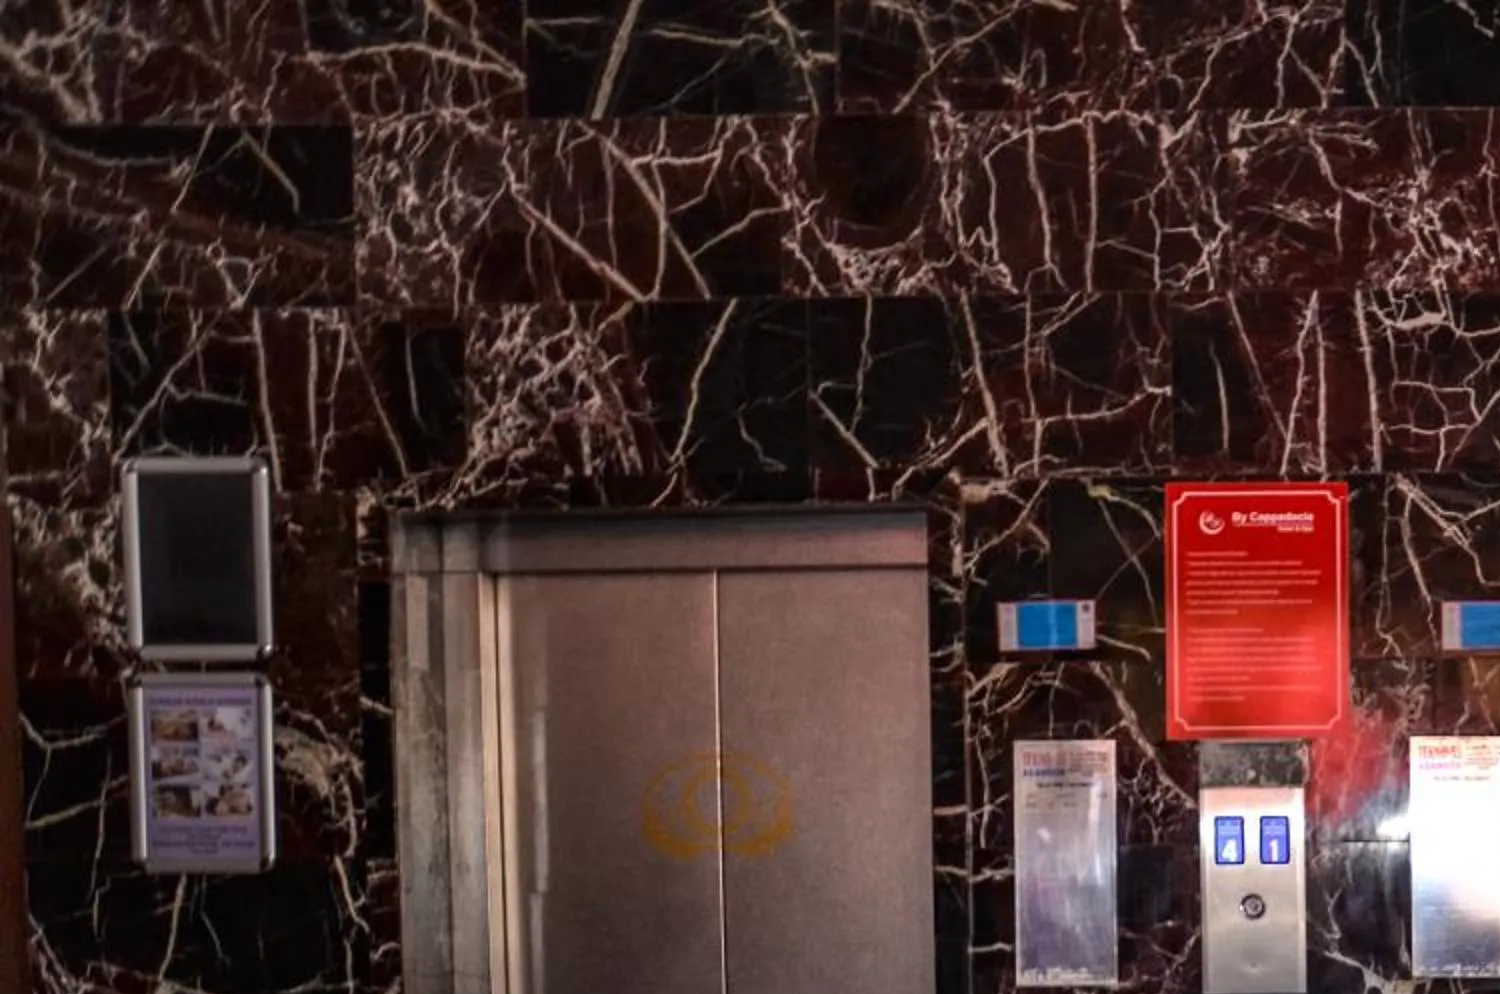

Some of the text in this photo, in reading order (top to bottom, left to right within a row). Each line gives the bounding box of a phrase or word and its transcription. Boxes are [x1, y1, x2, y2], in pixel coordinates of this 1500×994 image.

[1231, 511, 1247, 526] By
[1221, 838, 1238, 862] 4
[1269, 838, 1279, 862] 1
